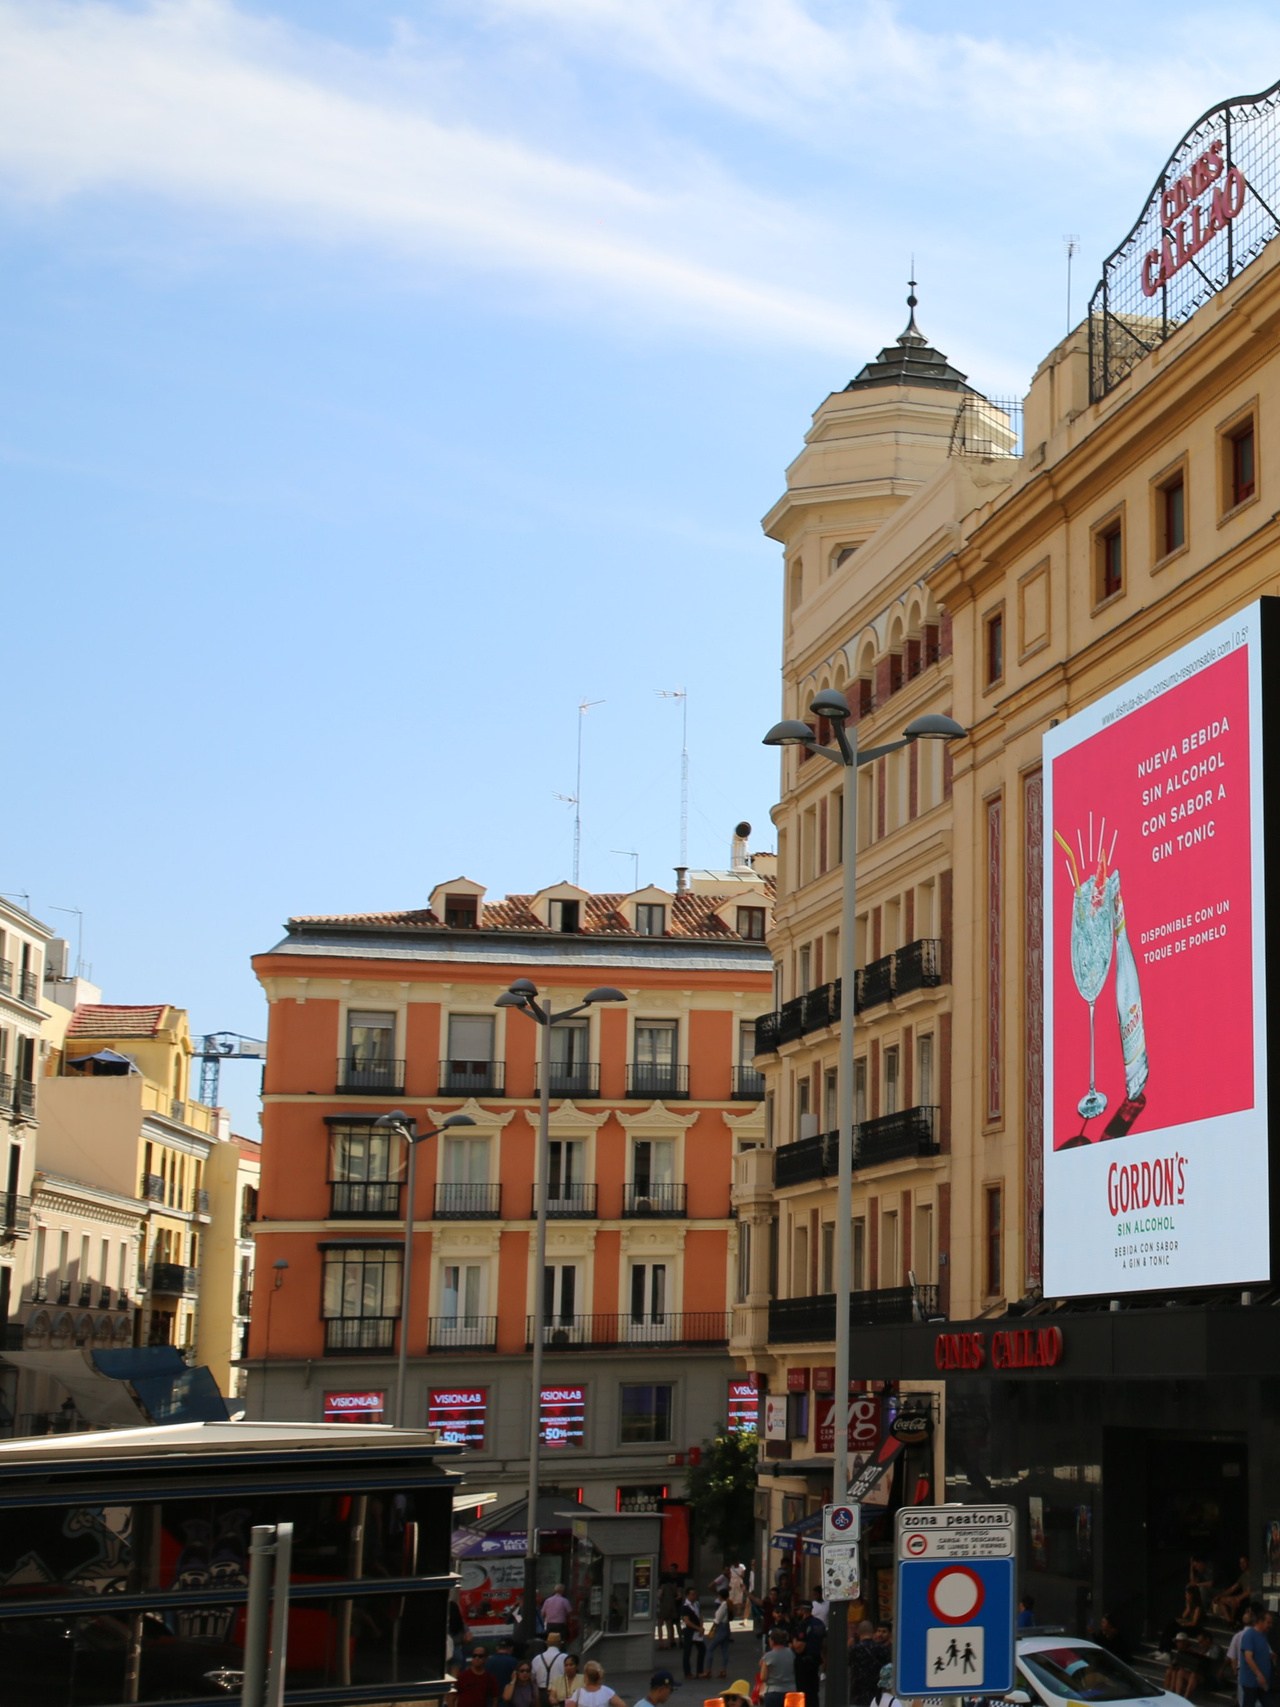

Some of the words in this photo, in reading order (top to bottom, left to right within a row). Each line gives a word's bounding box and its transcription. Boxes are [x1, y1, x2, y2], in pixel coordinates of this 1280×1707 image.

[1142, 167, 1245, 297] CALLAO
[1138, 745, 1178, 778] NUEVA
[1182, 716, 1230, 755] BEBIDA
[1142, 784, 1162, 806] SIN
[1166, 752, 1225, 794] ALCOHOL
[1142, 812, 1166, 836] CON
[1170, 790, 1213, 822] SABOR
[1218, 784, 1226, 800] A
[1152, 840, 1173, 862] GIN
[1177, 820, 1216, 851] TONIC
[1140, 914, 1192, 944] DISPONIBLE
[1194, 906, 1214, 923] CON
[1216, 900, 1230, 914] UN
[1144, 944, 1172, 964] TOQUE
[1174, 939, 1187, 953] DE
[1189, 924, 1227, 948] POMELO
[1108, 1152, 1186, 1216] GORDON'S
[1117, 1221, 1132, 1236] SIN
[1134, 1216, 1175, 1234] ALCOHOL
[1114, 1244, 1138, 1258] BEBIDA
[1140, 1242, 1154, 1254] CON
[1156, 1240, 1179, 1252] SABOR
[1122, 1259, 1126, 1270] A
[1129, 1257, 1140, 1268] GIN
[1143, 1256, 1147, 1266] &
[1150, 1255, 1170, 1266] TONIC
[935, 1332, 985, 1370] CINES
[991, 1326, 1064, 1370] CALLAO
[330, 1396, 380, 1407] VISIONLAB
[434, 1394, 482, 1404] VISIONLAB
[846, 1481, 869, 1496] DOG
[858, 1466, 882, 1482] HOT
[904, 1516, 937, 1526] zona
[946, 1512, 1008, 1526] peatonal
